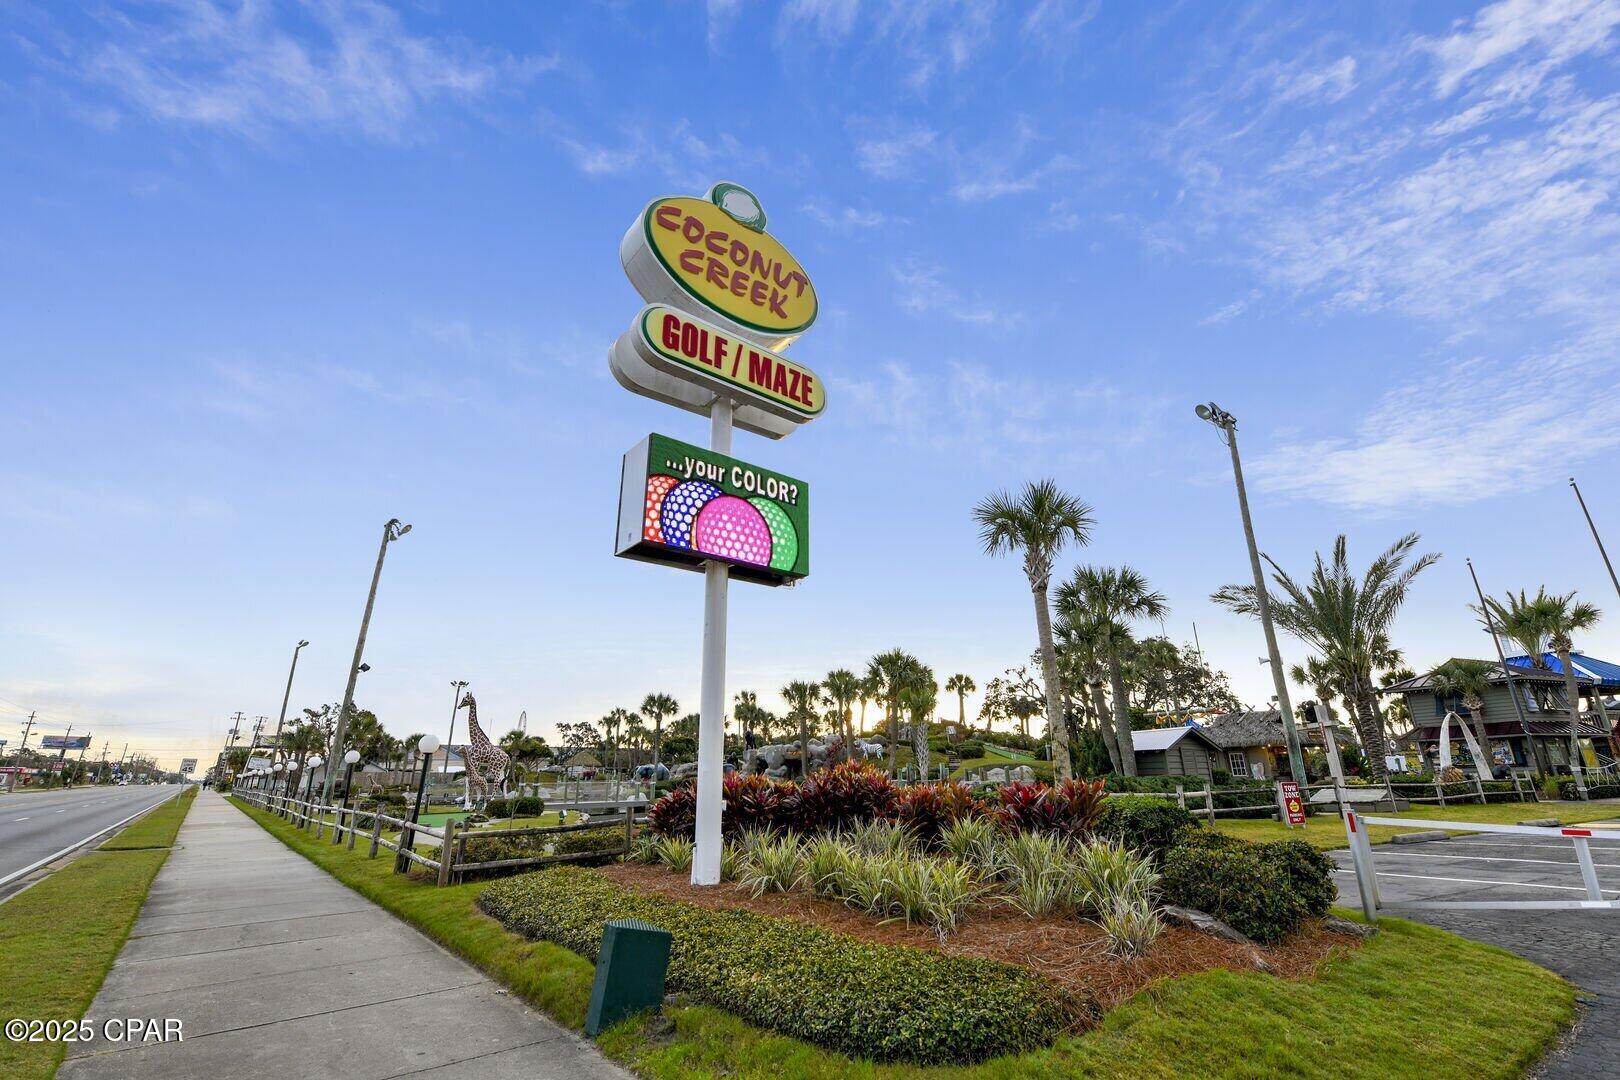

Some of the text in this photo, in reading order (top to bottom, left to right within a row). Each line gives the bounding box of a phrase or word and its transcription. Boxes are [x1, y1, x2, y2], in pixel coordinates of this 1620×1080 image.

[656, 205, 809, 297] COCONUT
[680, 249, 788, 319] CREEK
[662, 314, 728, 369] GOLF
[748, 350, 813, 407] MAZE
[666, 456, 798, 504] ...your COLOR?
